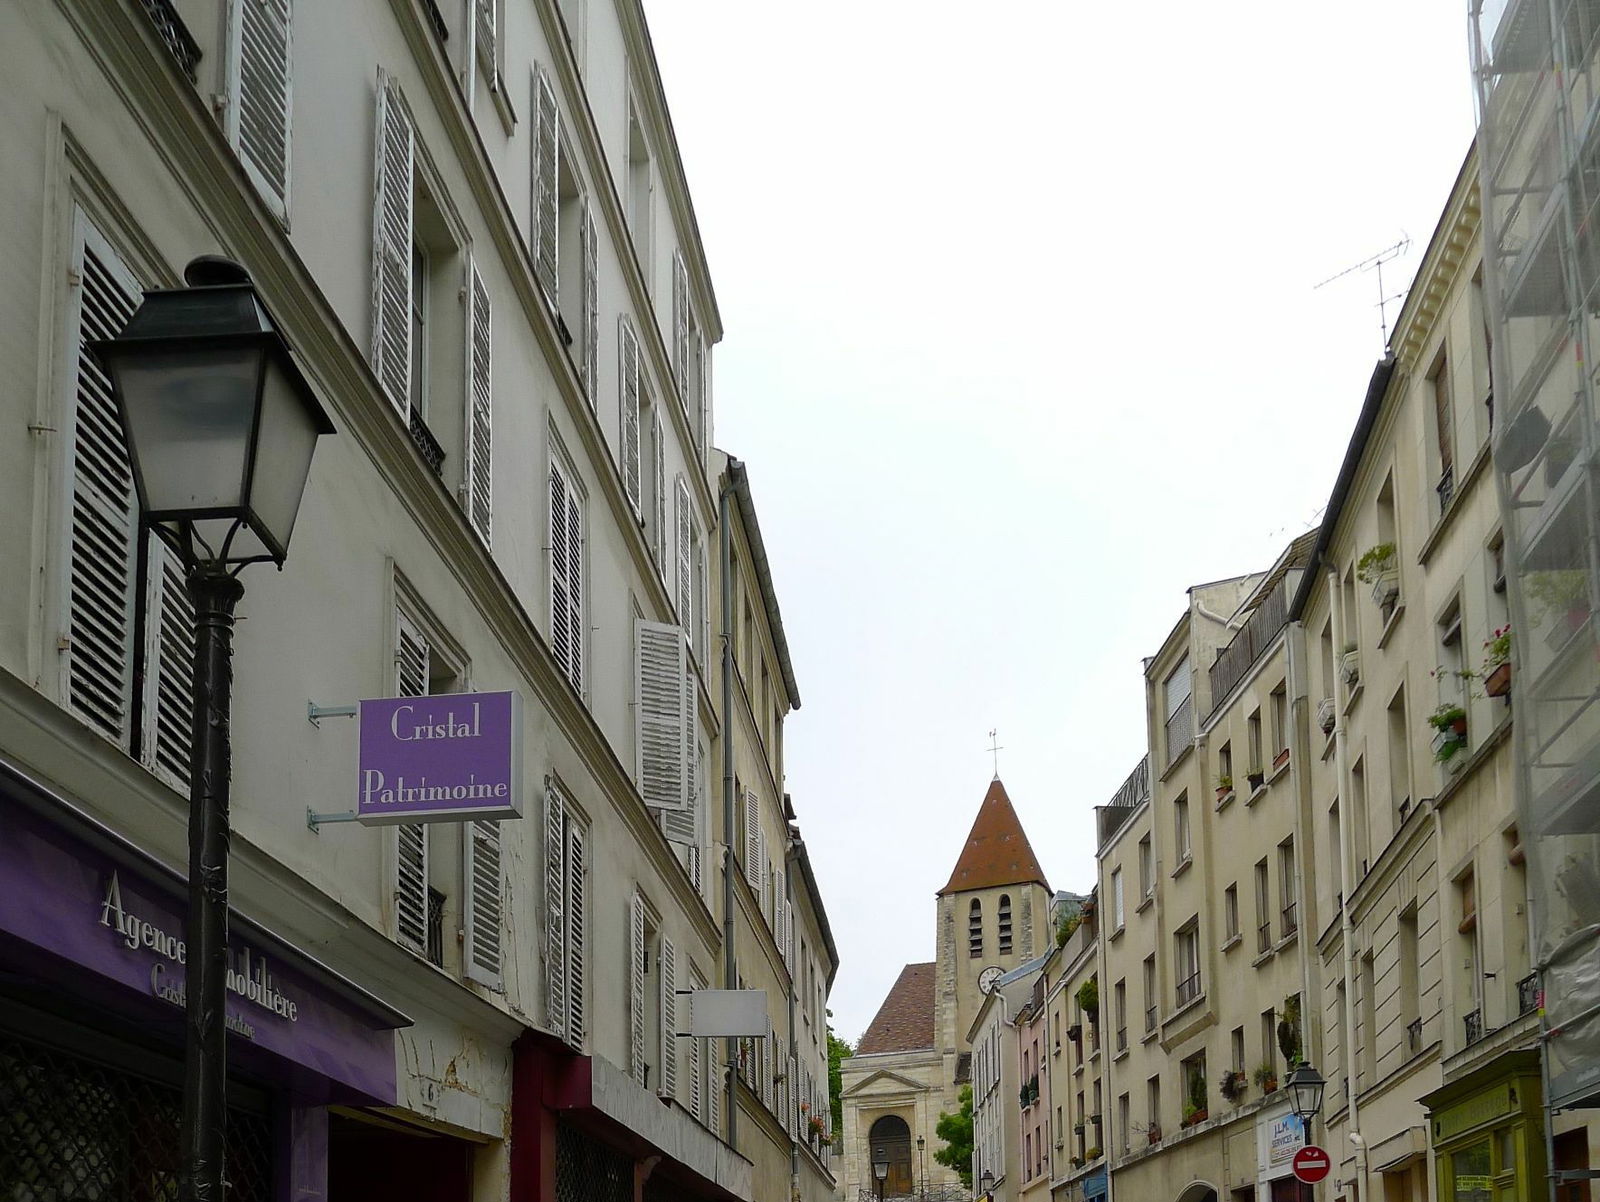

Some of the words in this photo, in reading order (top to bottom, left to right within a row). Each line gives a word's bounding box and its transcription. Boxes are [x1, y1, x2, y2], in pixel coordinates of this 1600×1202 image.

[390, 702, 482, 742] Cristal
[362, 769, 508, 804] Patrimoine
[99, 868, 187, 965] Agence
[226, 945, 298, 1022] mobilière
